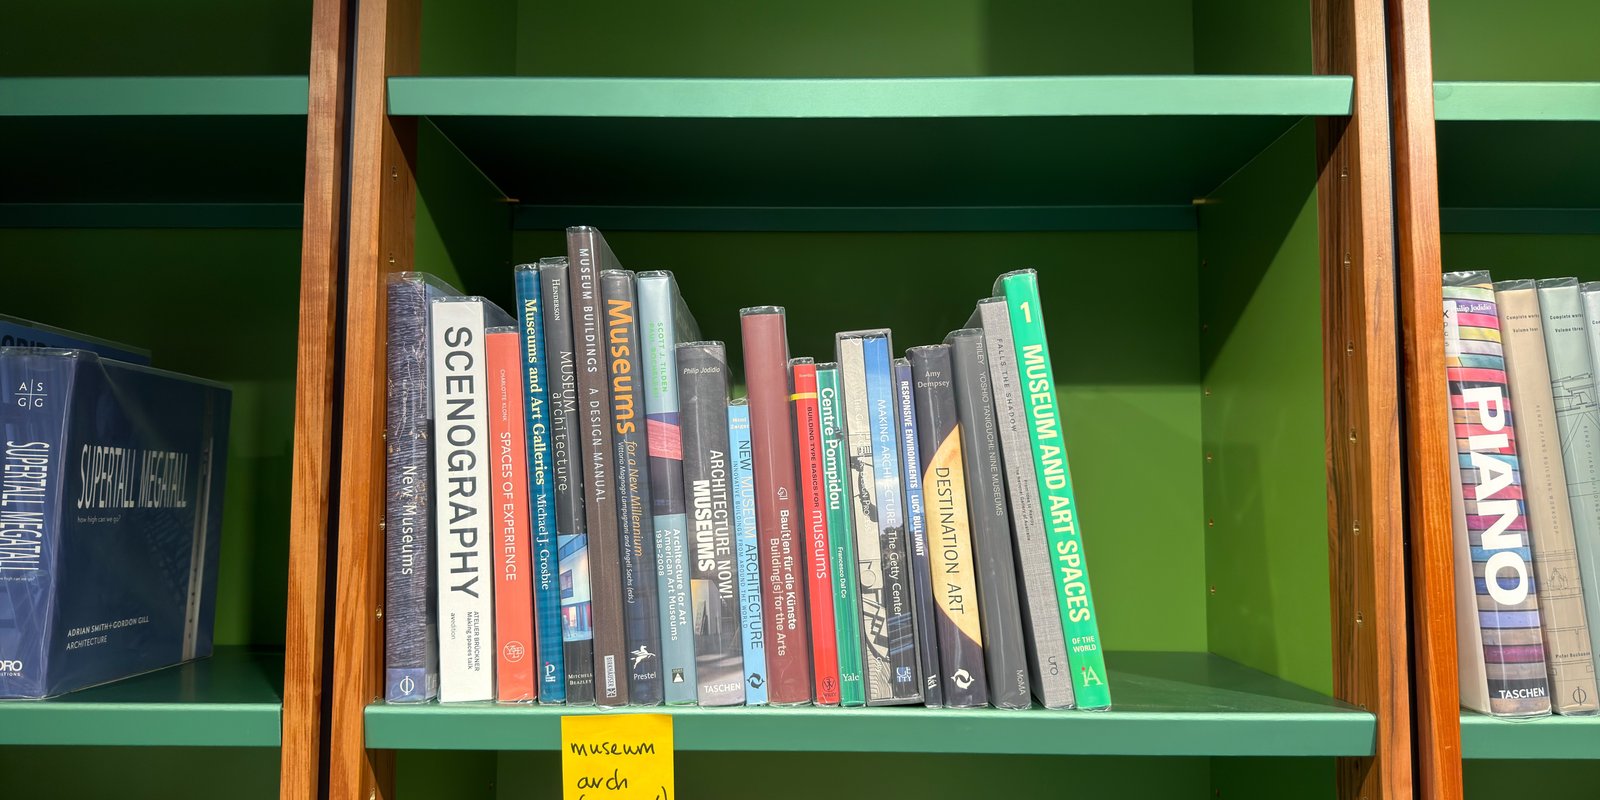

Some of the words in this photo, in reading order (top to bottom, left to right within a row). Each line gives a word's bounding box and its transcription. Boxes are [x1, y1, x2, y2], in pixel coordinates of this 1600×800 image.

[579, 248, 593, 300] MUSEUM
[552, 279, 561, 321] HENDERSON
[1019, 301, 1032, 324] 1
[1470, 304, 1492, 312] Jodidio
[525, 299, 542, 364] Museums
[582, 306, 598, 373] BUILDINGS
[608, 300, 636, 434] Museums
[975, 342, 984, 364] RILEY
[530, 368, 542, 393] and
[560, 352, 576, 414] MUSEUM
[660, 362, 669, 392] TILDEN
[684, 367, 700, 375] Philip
[700, 366, 720, 374] Jodidio
[918, 380, 950, 388] Dempsey
[925, 370, 940, 379] Amy
[997, 338, 1007, 367] FALLS
[1002, 370, 1010, 388] THE
[1006, 392, 1017, 432] SHADOW
[19, 382, 27, 391] A
[37, 382, 43, 391] S
[978, 371, 989, 402] YOSHIO
[1022, 344, 1058, 440] MUSEUM
[18, 398, 26, 406] G
[34, 399, 43, 407] G
[531, 397, 544, 420] Art
[822, 388, 834, 436] Centre
[901, 381, 912, 427] RESPONSIVE
[590, 401, 602, 446] DESIGN
[878, 400, 890, 443] MAKING
[982, 404, 995, 450] TANIGUCHI:
[501, 432, 514, 478] SPACES
[532, 423, 546, 485] Galleries
[552, 393, 567, 491] architecture
[617, 441, 626, 464] Vittorio
[623, 438, 638, 456] for
[738, 440, 752, 471] NEW
[3, 441, 50, 506] SUPERTALL
[446, 326, 479, 599] SCENOGRAPHY
[904, 428, 918, 489] ENVIRONMENTS
[988, 451, 998, 473] NINE
[1040, 444, 1066, 490] AND
[78, 444, 136, 509] SUPERTALL
[139, 449, 187, 508] MEGATALL
[402, 466, 417, 498] New
[502, 482, 514, 496] OF
[592, 452, 606, 503] MANUAL
[617, 465, 628, 494] Magnago
[628, 467, 640, 492] New
[826, 440, 842, 510] Pompidou
[882, 446, 896, 524] ARCHITECTURE
[710, 450, 731, 560] ARCHITECTURE
[741, 476, 756, 539] MUSEUM
[911, 494, 920, 514] LUCY
[990, 474, 1003, 515] MUSEUMS
[1462, 386, 1528, 606] PIANO
[88, 516, 97, 524] high
[536, 494, 548, 535] Michael
[619, 495, 630, 534] Lampugnani
[628, 495, 645, 556] Millennium
[693, 480, 716, 572] MUSEUMS
[1023, 520, 1031, 540] Australia
[1048, 496, 1075, 536] ART
[0, 511, 44, 572] MEGATALL
[402, 505, 416, 575] Museums
[504, 504, 516, 581] EXPERIENCE
[537, 536, 548, 547] J.
[664, 530, 674, 570] American
[812, 511, 826, 579] museums
[886, 530, 898, 550] The
[913, 516, 924, 557] BULLIVANT
[936, 467, 960, 574] DESTINATION
[948, 583, 964, 614] ART
[537, 549, 550, 590] Crosbie
[623, 548, 632, 567] Angeli
[673, 529, 684, 590] Architecture
[783, 556, 794, 572] für
[889, 552, 900, 580] Getty
[625, 568, 633, 585] Sachs
[667, 574, 675, 590] Art
[717, 564, 733, 600] NOW!
[785, 573, 794, 590] die
[1056, 540, 1090, 622] SPACES
[626, 587, 635, 603] (eds.)
[677, 591, 685, 604] for
[744, 544, 763, 650] ARCHITECTURE
[774, 595, 784, 612] for
[842, 590, 846, 598] Co
[892, 584, 902, 616] Center
[68, 626, 90, 637] ADRIAN
[138, 615, 150, 624] GILL
[668, 594, 678, 641] Museums
[678, 608, 686, 625] Art
[776, 613, 785, 632] the
[786, 592, 796, 630] Künste
[66, 635, 108, 650] ARCHITECTURE
[778, 634, 786, 656] Arts
[1072, 637, 1080, 645] OF
[1082, 636, 1095, 644] THE
[1072, 644, 1096, 653] WORLD
[633, 673, 656, 681] Prestel
[842, 674, 860, 682] Yale
[1048, 656, 1058, 676] uro
[704, 682, 741, 693] TASCHEN
[1016, 670, 1026, 696] MoMA
[1499, 686, 1545, 700] TASCHEN
[570, 742, 655, 756] museum
[577, 768, 628, 790] arch
